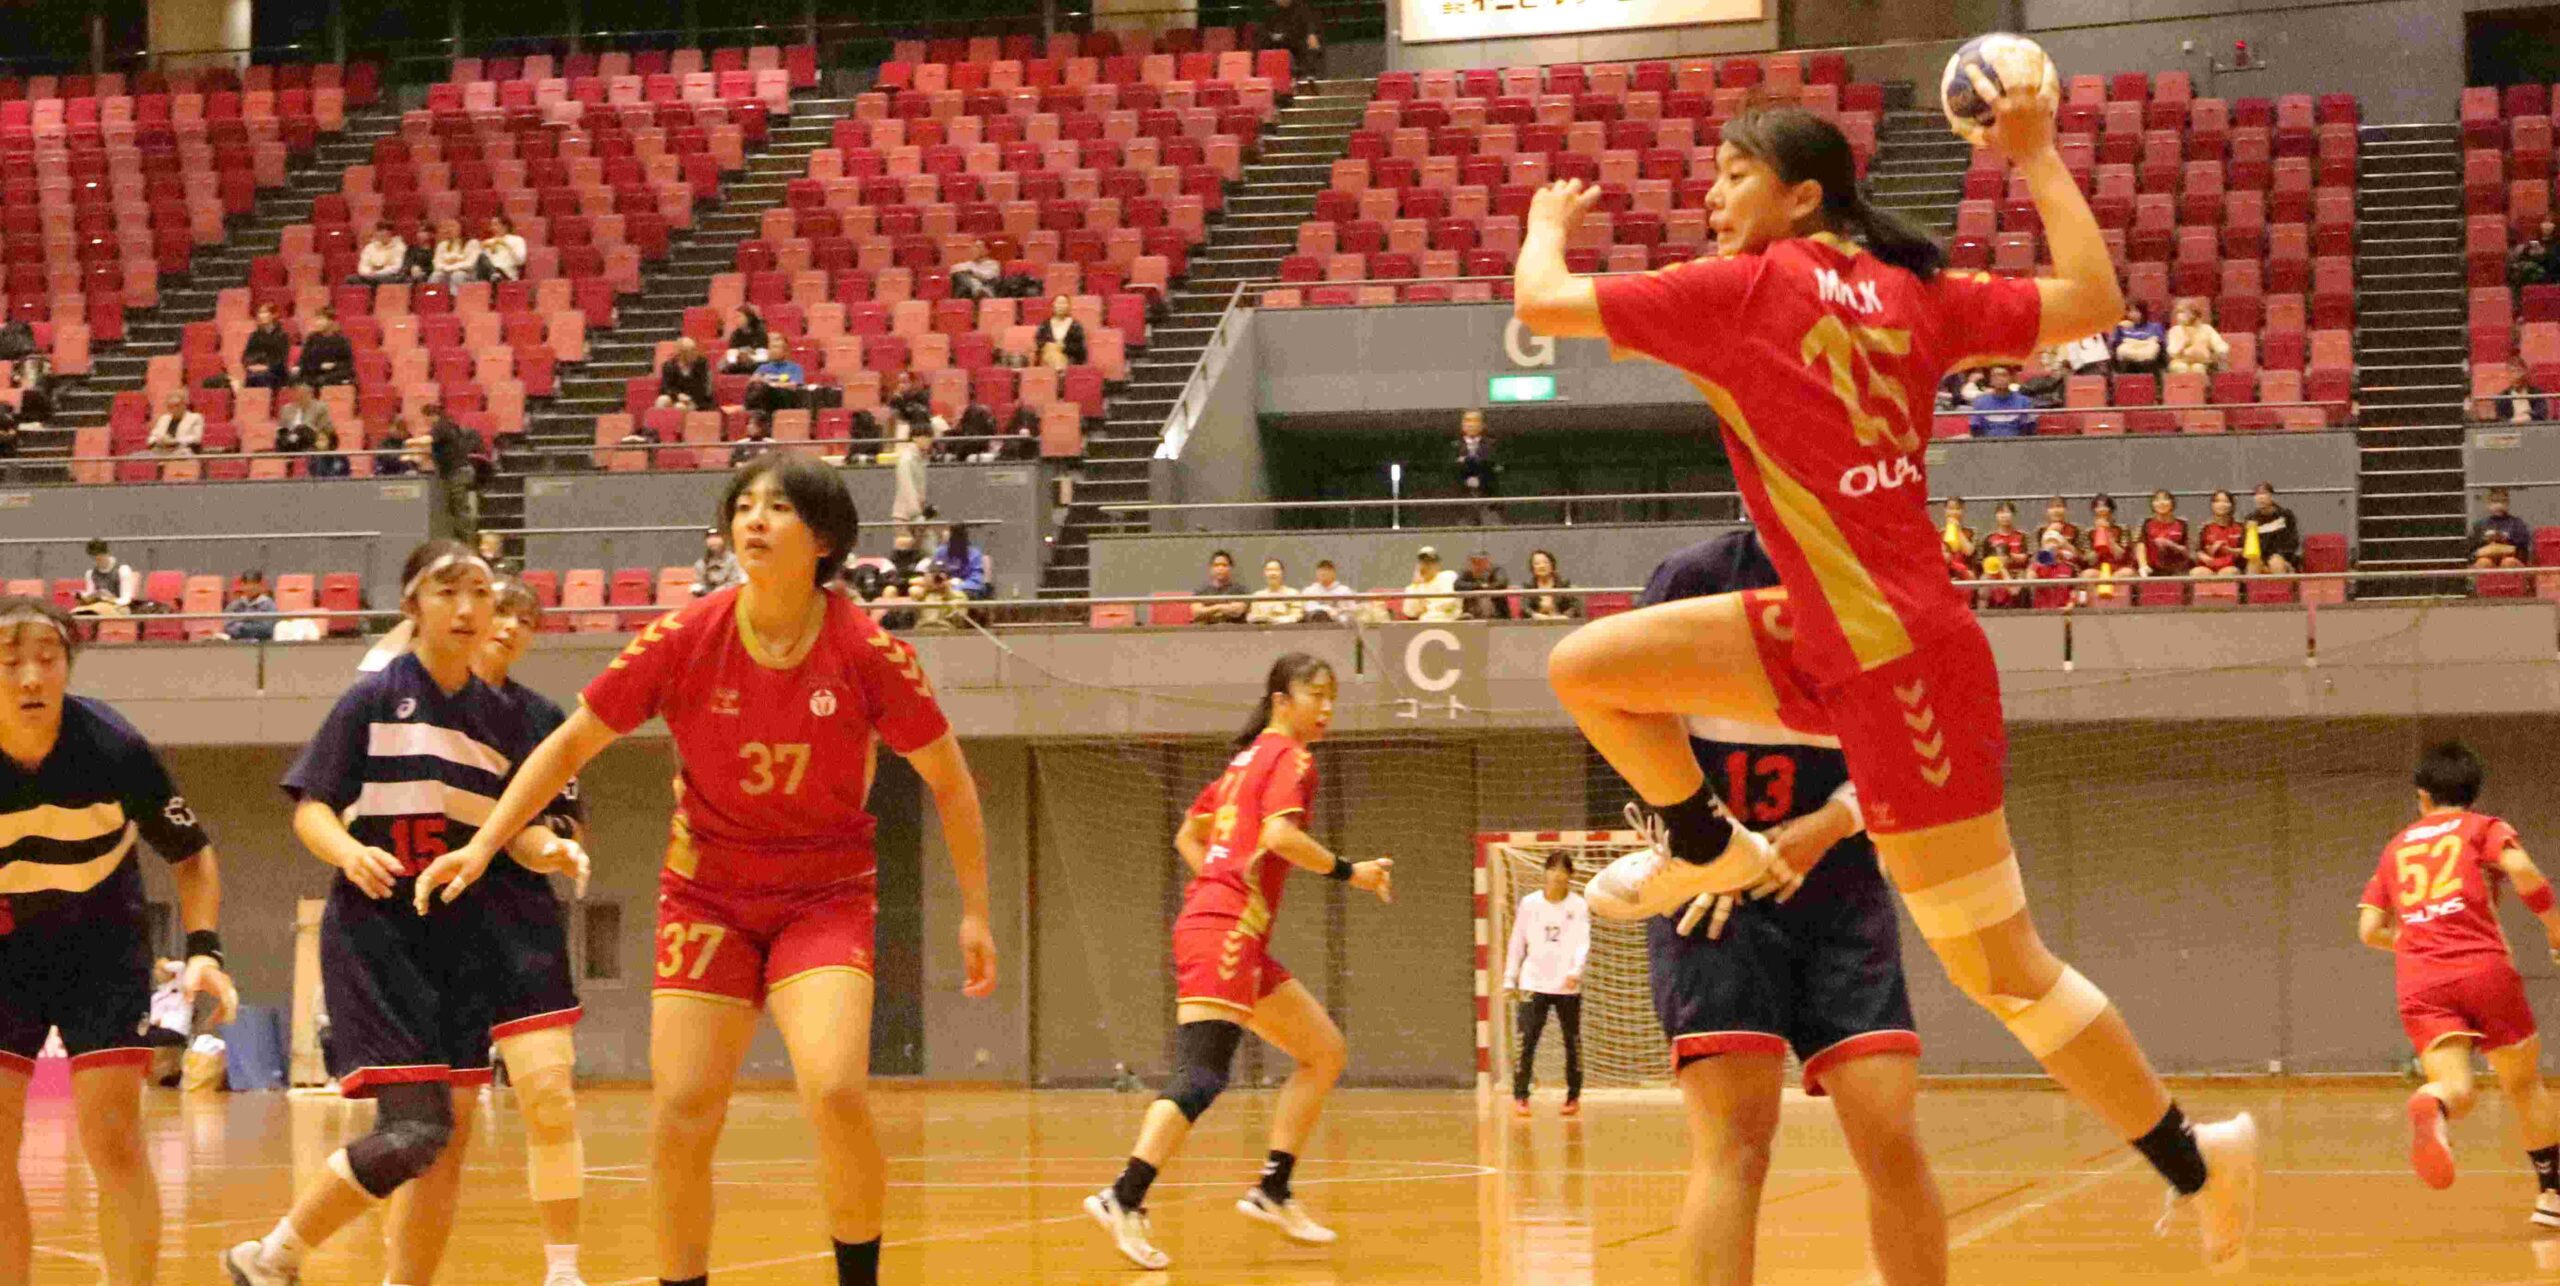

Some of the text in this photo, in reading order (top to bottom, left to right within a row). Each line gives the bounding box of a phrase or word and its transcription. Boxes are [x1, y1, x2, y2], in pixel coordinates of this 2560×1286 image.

[1504, 316, 1554, 367] G
[1801, 314, 1921, 447] 15
[1404, 629, 1461, 691] C
[1394, 694, 1471, 719] コート
[739, 742, 811, 794] 37
[1727, 751, 1796, 823] 13
[390, 816, 448, 877] 15
[2396, 834, 2463, 907] 52
[657, 922, 725, 979] 37
[1544, 926, 1560, 942] 12
